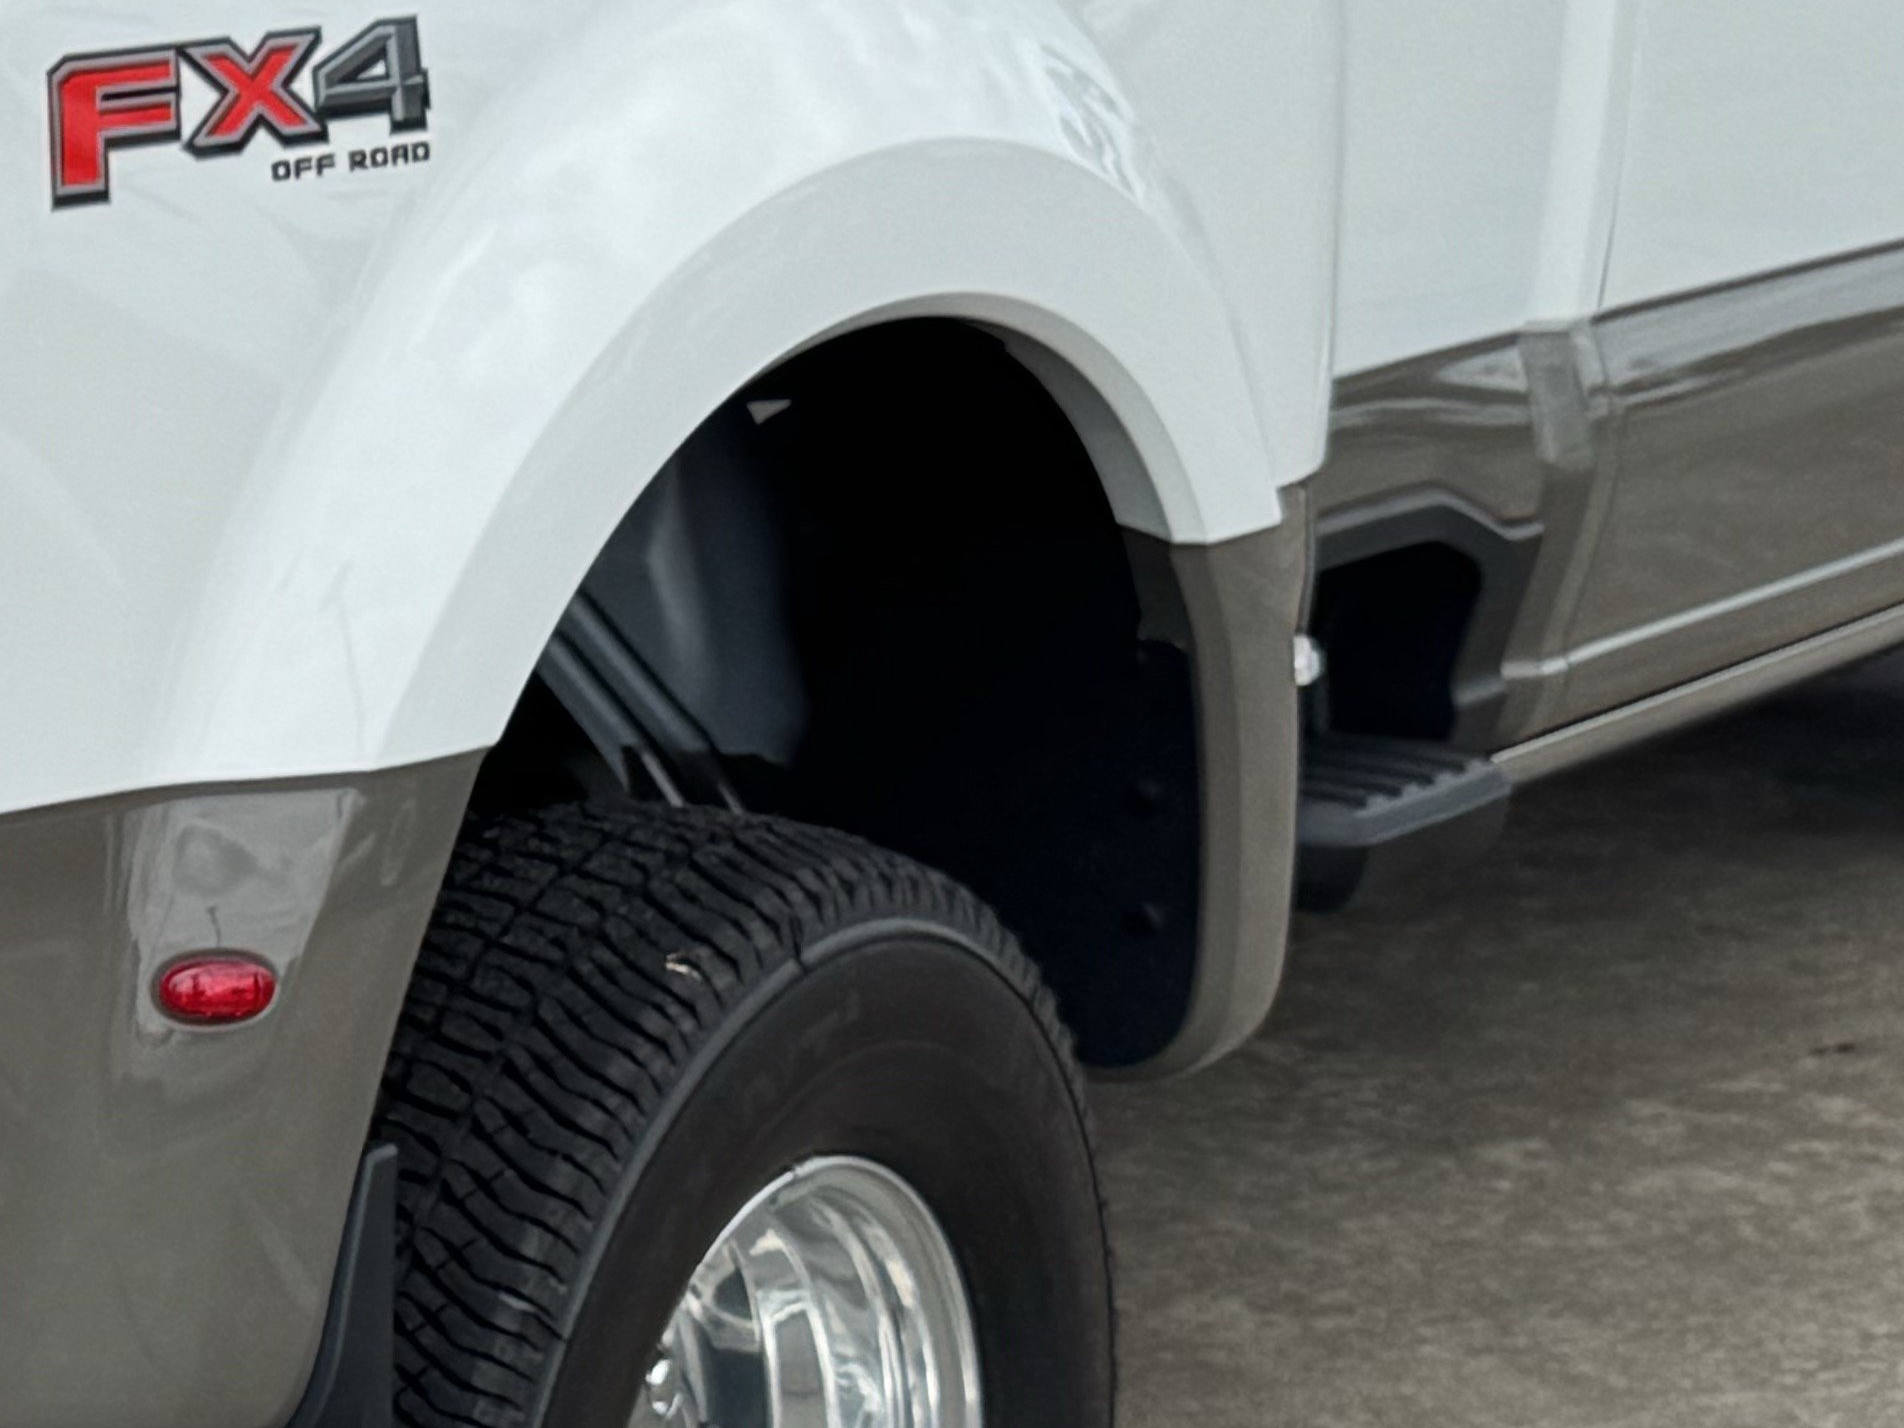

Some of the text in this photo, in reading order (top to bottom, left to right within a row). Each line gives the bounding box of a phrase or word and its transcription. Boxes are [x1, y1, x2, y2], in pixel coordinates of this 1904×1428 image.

[46, 13, 431, 212] FX4
[270, 140, 432, 183] OFF ROAD
